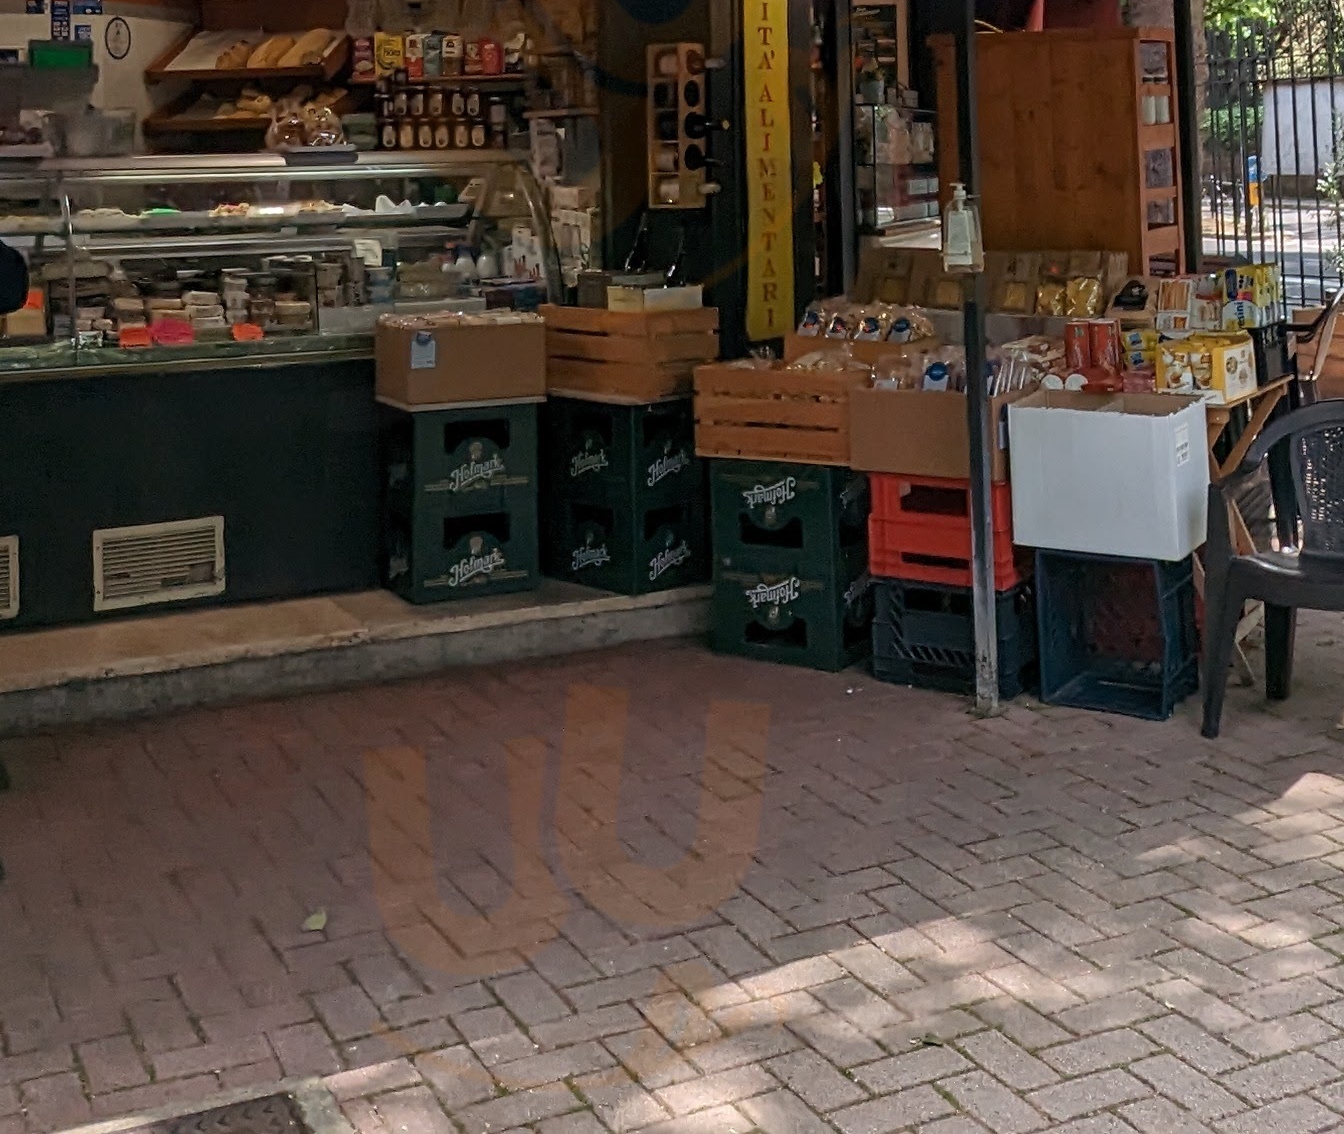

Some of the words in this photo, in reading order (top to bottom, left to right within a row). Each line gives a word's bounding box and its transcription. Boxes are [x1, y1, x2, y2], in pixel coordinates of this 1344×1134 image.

[450, 453, 505, 492] Hofmark
[743, 476, 796, 509] Hofmark
[448, 547, 505, 586] Hofmark
[745, 576, 801, 609] Hofmark
